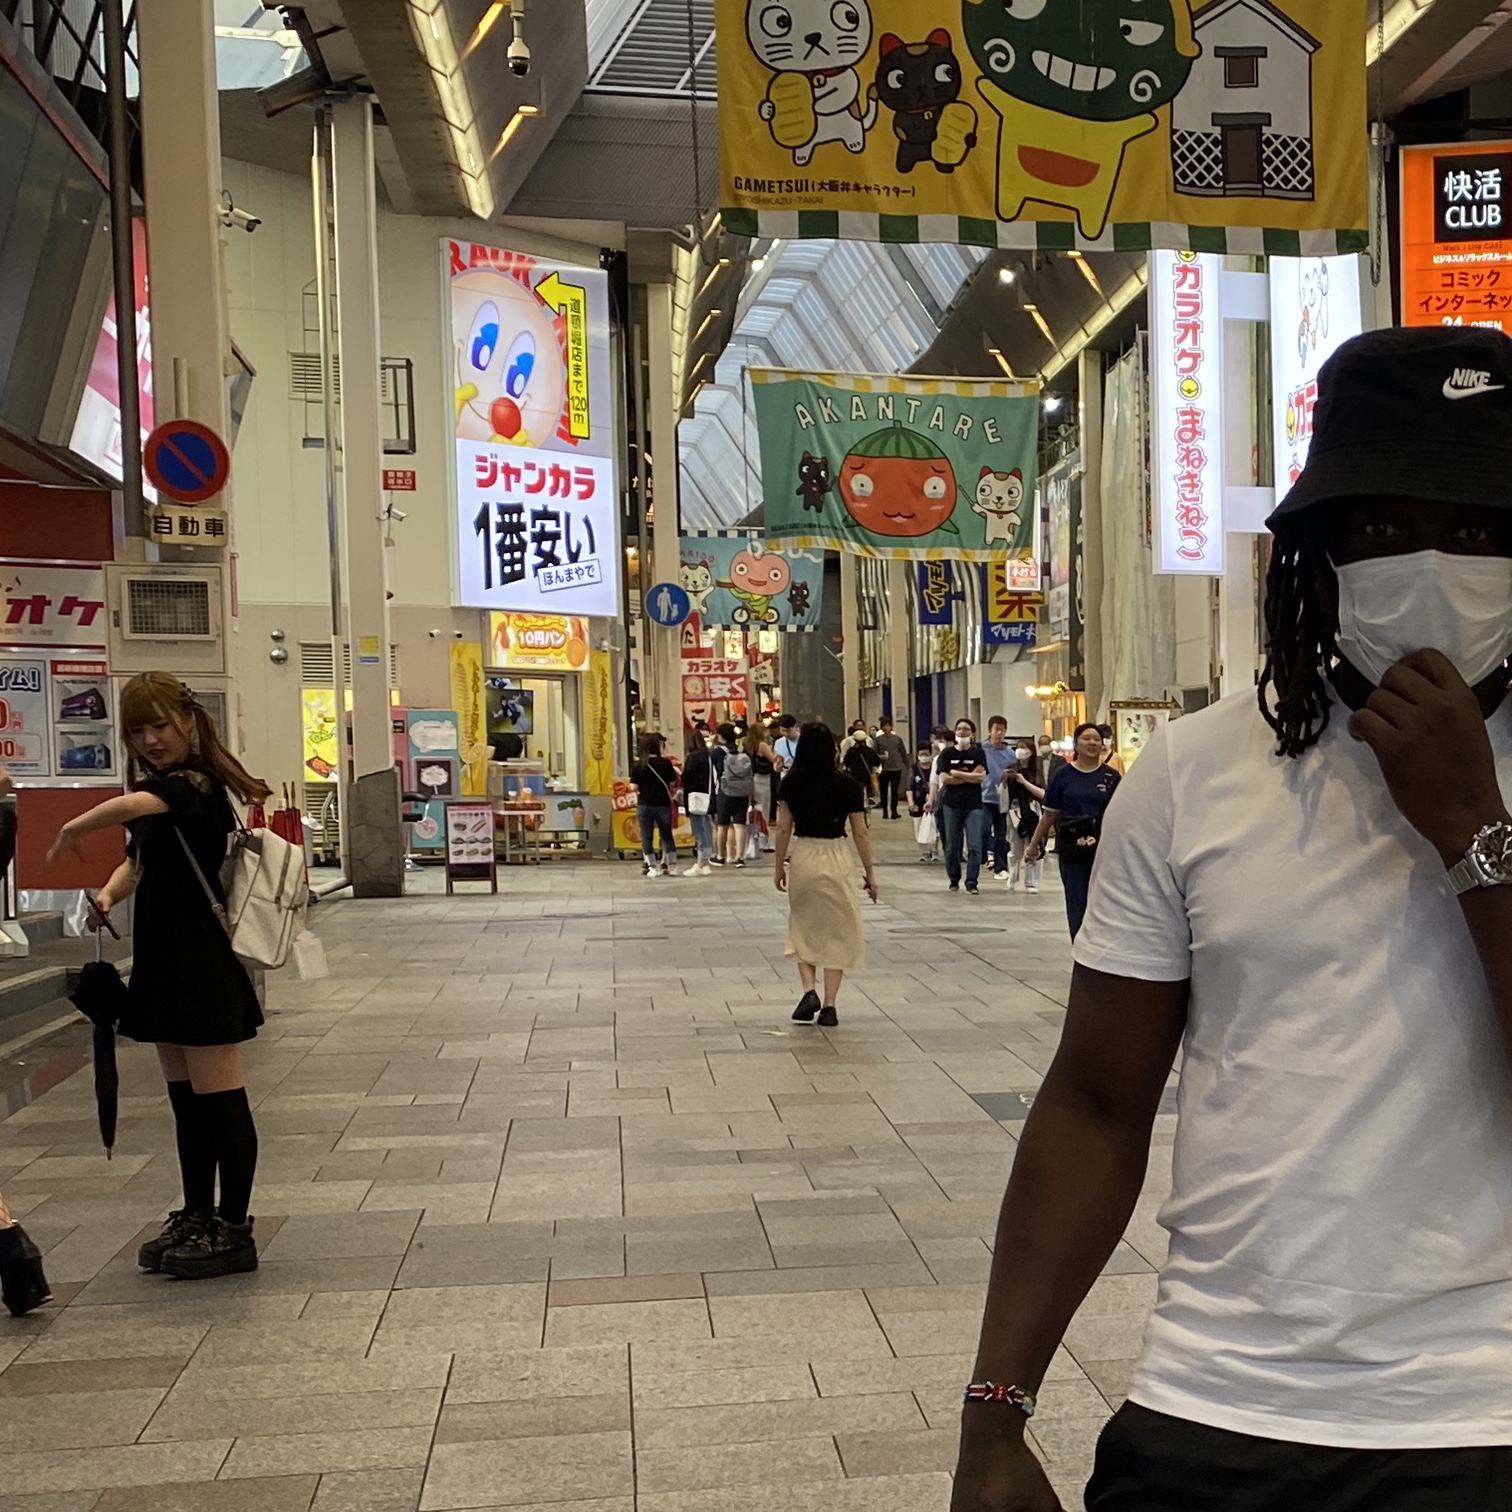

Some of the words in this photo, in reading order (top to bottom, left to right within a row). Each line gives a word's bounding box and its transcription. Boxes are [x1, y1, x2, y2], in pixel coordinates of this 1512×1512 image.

[1444, 168, 1502, 201] 快活
[1445, 204, 1502, 228] CLUB
[1441, 269, 1500, 288] コミック
[1164, 264, 1204, 377] カラオケ
[1451, 368, 1491, 386] NIKE
[794, 396, 1002, 444] AKANTARE
[475, 453, 596, 501] ジャンカラ
[1166, 405, 1208, 560] まねきねこ
[153, 515, 226, 538] 自動車
[473, 501, 596, 591] 1番安い
[542, 565, 596, 586] ほんまやで
[5, 594, 104, 626] オケ
[517, 629, 566, 646] 10円パン
[687, 660, 739, 672] カラオケ
